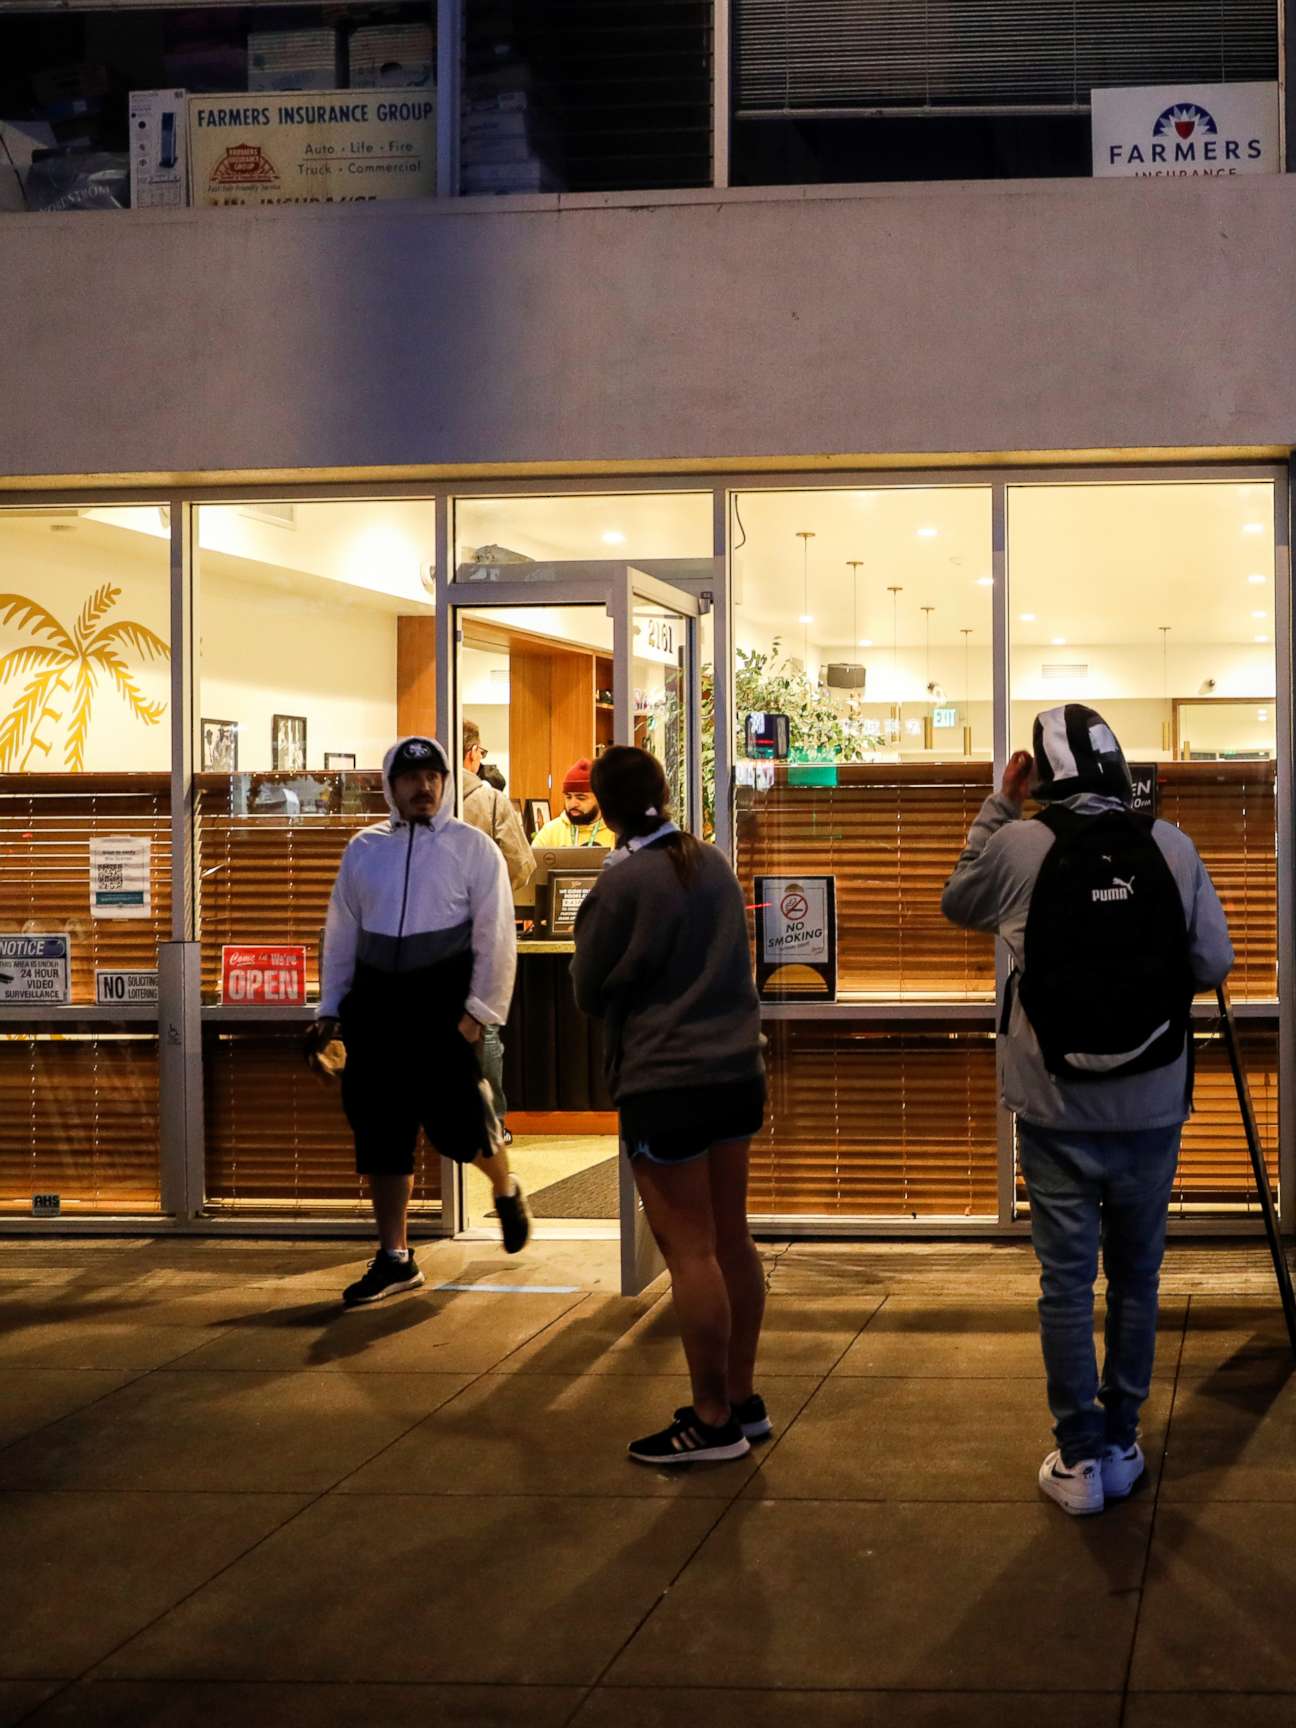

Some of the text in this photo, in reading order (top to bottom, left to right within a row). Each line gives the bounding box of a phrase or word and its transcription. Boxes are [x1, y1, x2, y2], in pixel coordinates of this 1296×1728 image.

[198, 102, 433, 127] FARMERS INSURANCE GROUP
[304, 140, 414, 155] Auto Life Fire
[1109, 139, 1262, 164] FARMERS
[298, 161, 422, 176] Truck Commercial
[1092, 887, 1128, 902] PUMA
[786, 922, 804, 933] NO
[768, 929, 823, 948] SMOKING
[0, 941, 45, 956] NOTICE
[20, 969, 59, 978] 24 HOUR
[27, 980, 54, 989] VIDEO
[104, 976, 125, 999] NO
[228, 969, 298, 1000] OPEN
[5, 990, 60, 999] SURVEILLANCE
[34, 1195, 60, 1208] AHS
